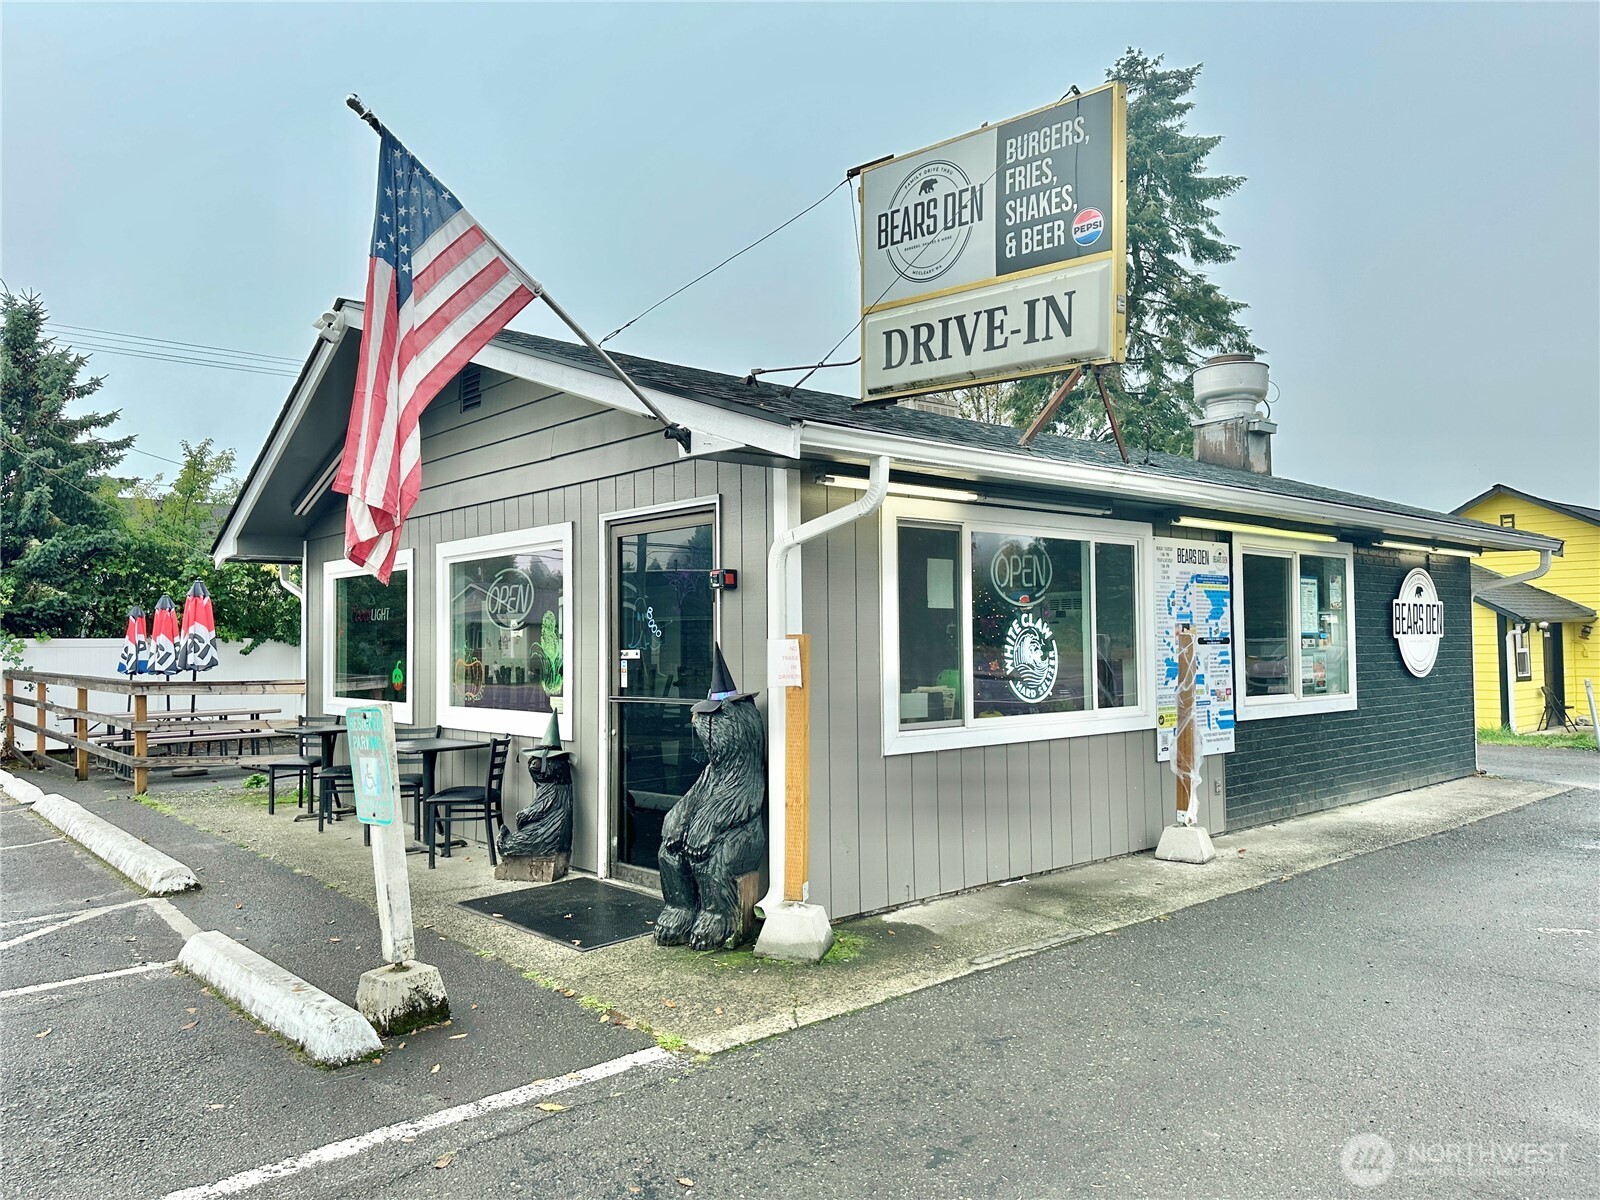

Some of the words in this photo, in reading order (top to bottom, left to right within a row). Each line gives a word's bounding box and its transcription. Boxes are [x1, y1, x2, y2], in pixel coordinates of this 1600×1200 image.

[1005, 116, 1090, 165] BURGERS,
[904, 172, 922, 189] FAMILY
[924, 167, 940, 175] DRIVE
[940, 167, 953, 175] THRU
[1005, 157, 1058, 195] FRIES,
[877, 197, 938, 250] BEARS
[943, 182, 984, 232] DEN
[1005, 184, 1079, 227] SHAKES,
[1005, 232, 1016, 259] &
[1022, 219, 1065, 255] BEER
[1073, 220, 1102, 235] PEPSI
[882, 290, 1076, 371] DRIVE-IN
[997, 554, 1046, 588] OPEN
[1177, 547, 1196, 564] BEARS
[1198, 549, 1209, 565] DEN
[370, 607, 390, 621] LIGHT
[488, 583, 530, 614] OPEN
[1394, 602, 1424, 635] BEARS
[1426, 603, 1443, 635] DEN
[1004, 619, 1021, 675] WHITE
[1021, 613, 1053, 639] CLAW
[1015, 681, 1036, 698] HARD
[1038, 650, 1055, 695] SELTZER
